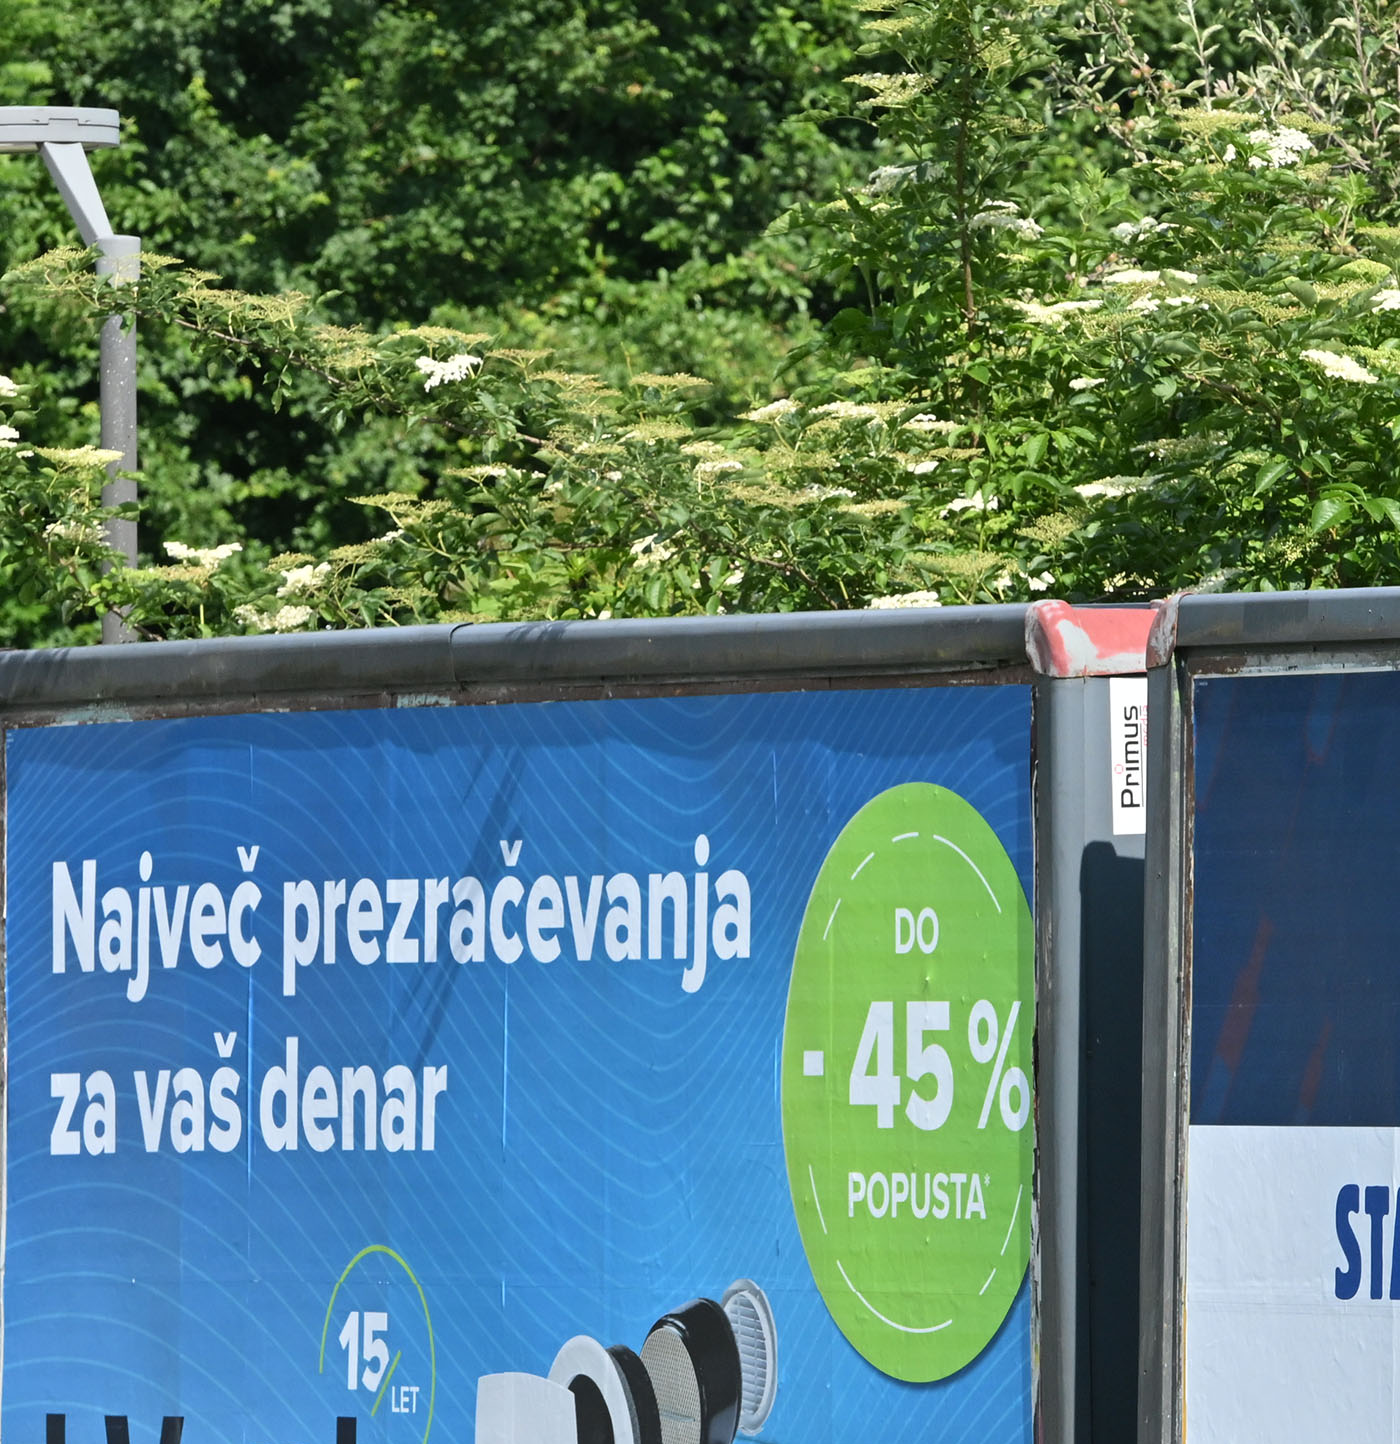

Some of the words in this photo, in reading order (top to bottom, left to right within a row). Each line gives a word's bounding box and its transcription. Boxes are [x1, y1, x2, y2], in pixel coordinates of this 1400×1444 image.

[1114, 705, 1141, 808] Primus
[51, 845, 262, 1002] Največ
[282, 834, 752, 996] prezračevanja
[895, 906, 939, 954] DO
[50, 1069, 116, 1156] za
[134, 1032, 242, 1153] vaš
[259, 1037, 448, 1153] denar
[338, 1310, 390, 1393] 15
[391, 1385, 420, 1414] LET
